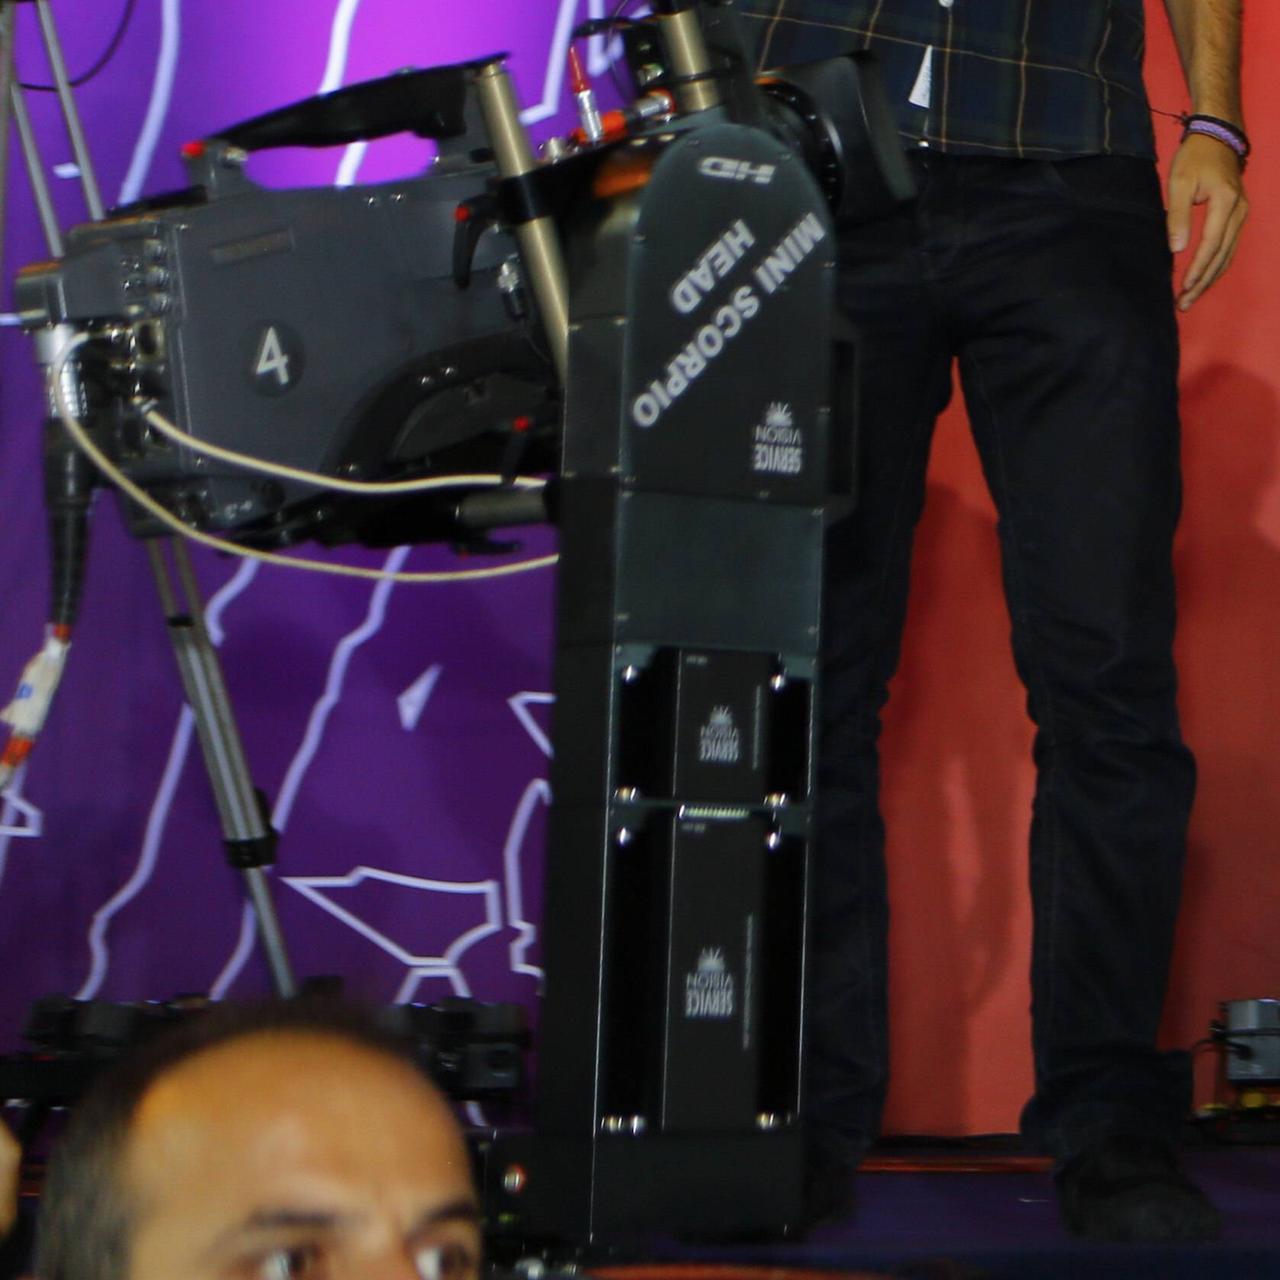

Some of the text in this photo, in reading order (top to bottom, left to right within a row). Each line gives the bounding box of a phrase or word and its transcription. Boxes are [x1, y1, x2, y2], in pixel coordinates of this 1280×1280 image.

[698, 156, 776, 184] HD
[670, 219, 756, 314] HEAD
[633, 212, 826, 428] MINI SCORPIO
[255, 325, 290, 384] 4
[754, 424, 801, 444] VISION
[753, 443, 802, 474] SERVICE
[685, 973, 734, 993] VISION
[685, 991, 734, 1016] SERVICE
